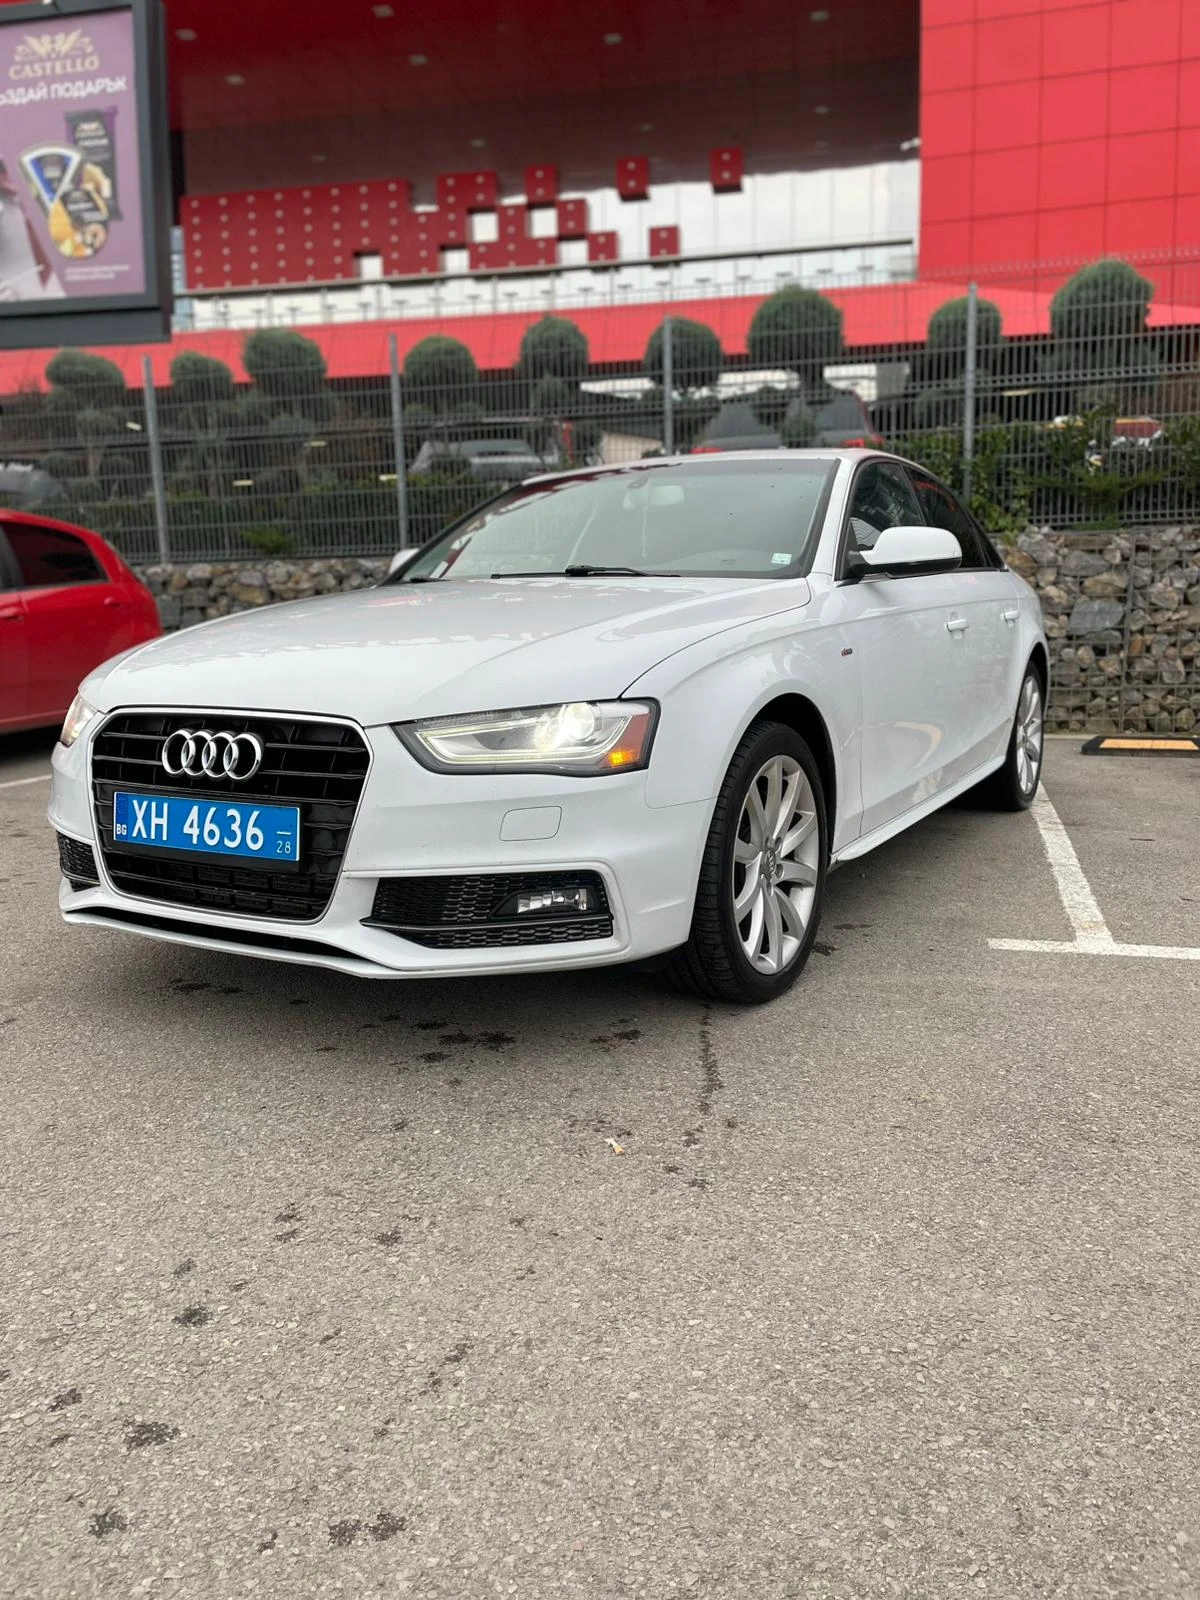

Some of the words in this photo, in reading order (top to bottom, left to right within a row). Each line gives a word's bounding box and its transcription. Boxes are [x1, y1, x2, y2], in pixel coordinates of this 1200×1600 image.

[8, 55, 100, 80] CASTELLO
[50, 75, 127, 100] ПОДАРЪК
[116, 823, 127, 836] BG
[132, 800, 168, 841] XH
[183, 805, 265, 851] 4636
[276, 840, 291, 854] 28
